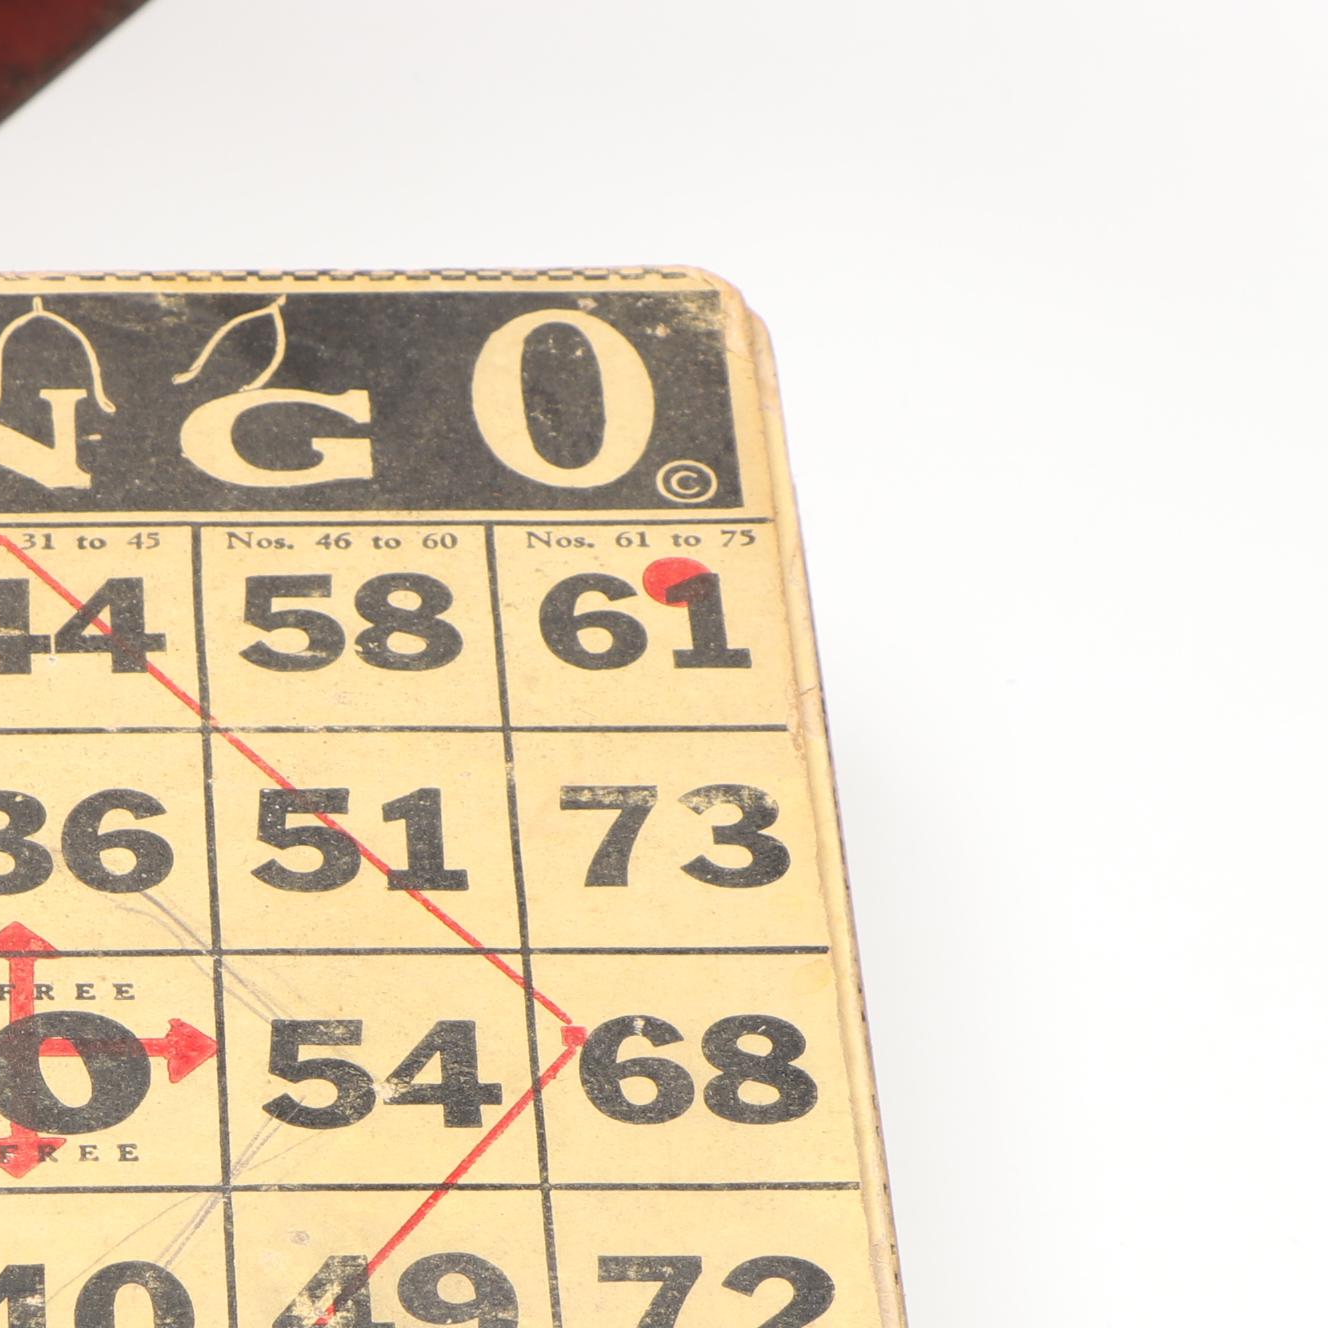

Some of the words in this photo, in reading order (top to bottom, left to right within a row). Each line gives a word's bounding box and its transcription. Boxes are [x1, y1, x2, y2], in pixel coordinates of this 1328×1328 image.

[21, 530, 57, 551] 31
[74, 530, 109, 552] to
[124, 530, 162, 551] 45
[225, 531, 295, 550] Nos.
[315, 532, 353, 551] 46
[371, 535, 402, 550] to
[421, 532, 458, 550] 60
[525, 530, 595, 549] Nos.
[615, 530, 650, 548] 61
[671, 533, 702, 548] to
[720, 528, 757, 548] 75
[238, 572, 464, 673] 58
[538, 572, 753, 671] 61
[250, 787, 470, 893] 51
[559, 783, 791, 889] 73
[261, 1018, 503, 1130] 54
[578, 1014, 819, 1126] 68
